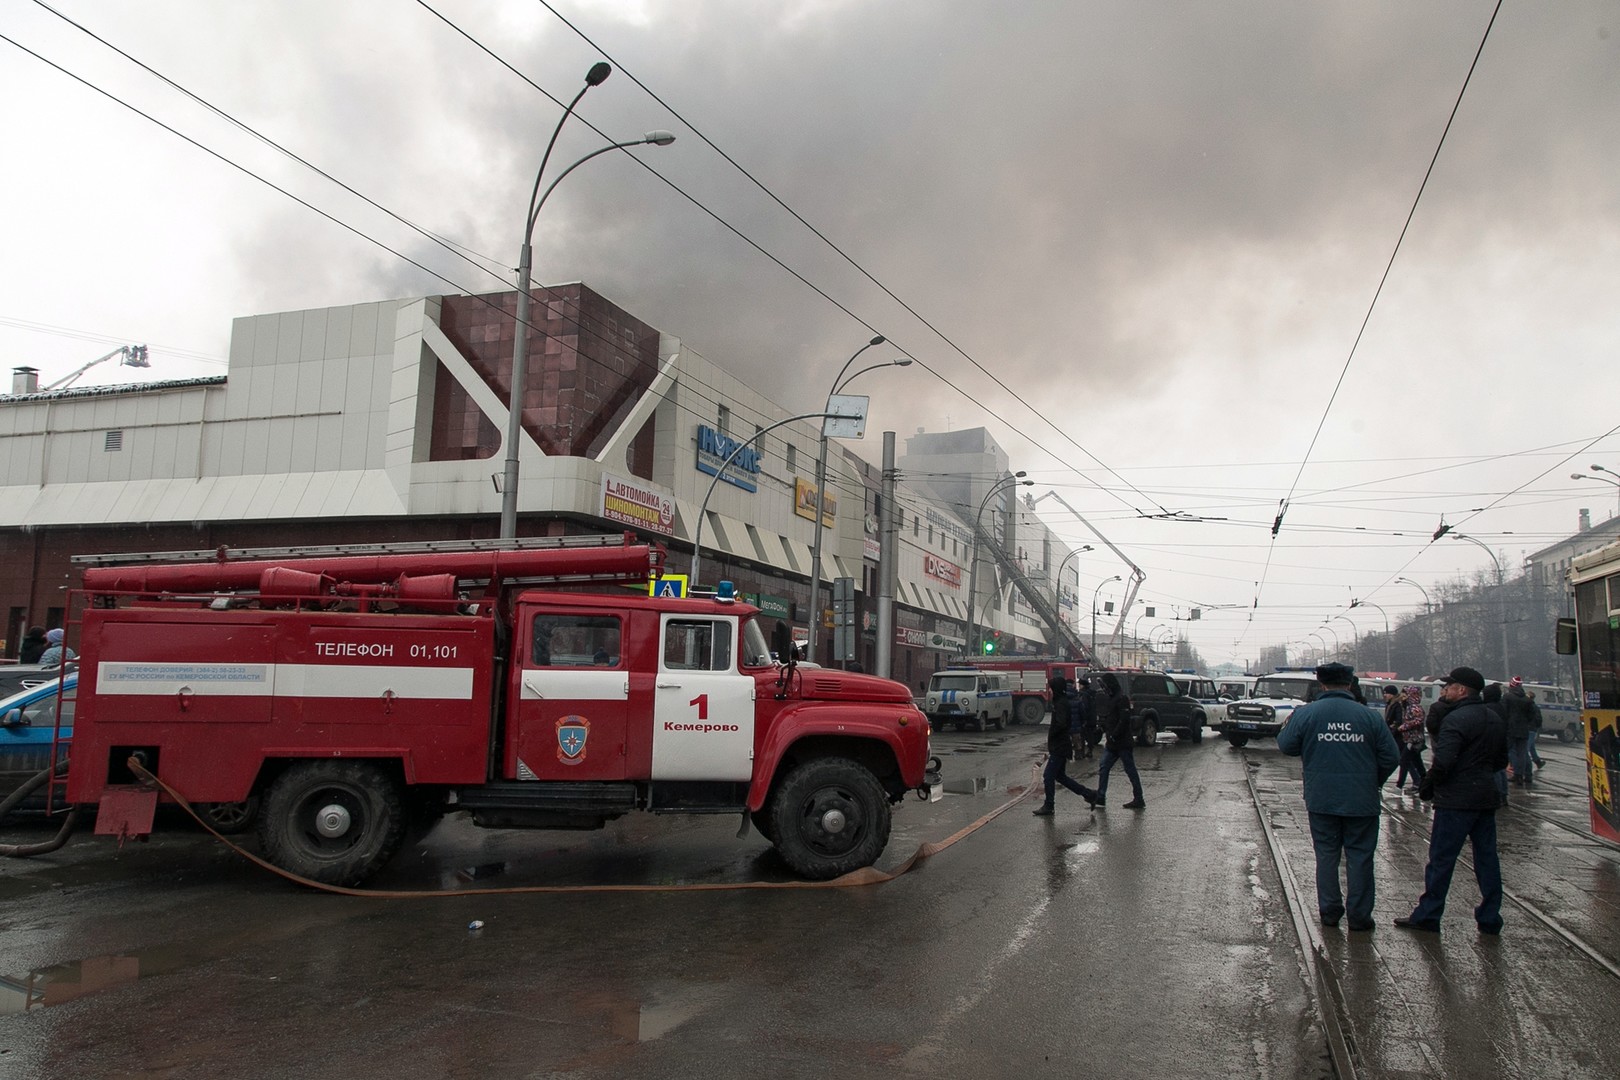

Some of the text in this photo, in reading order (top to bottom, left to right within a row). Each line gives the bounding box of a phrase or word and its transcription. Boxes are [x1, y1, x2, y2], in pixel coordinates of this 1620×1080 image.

[615, 482, 660, 508] АВТОМОЙКА
[605, 495, 660, 523] ШИНОМОНТАЖ
[662, 503, 670, 514] 24
[928, 556, 945, 578] DNS
[315, 642, 457, 660] ТЕЛЕФОН 01,101
[690, 694, 708, 720] 1
[664, 721, 739, 733] Кемерово
[1327, 722, 1352, 731] МЧС
[1317, 733, 1364, 742] РОССИИ
